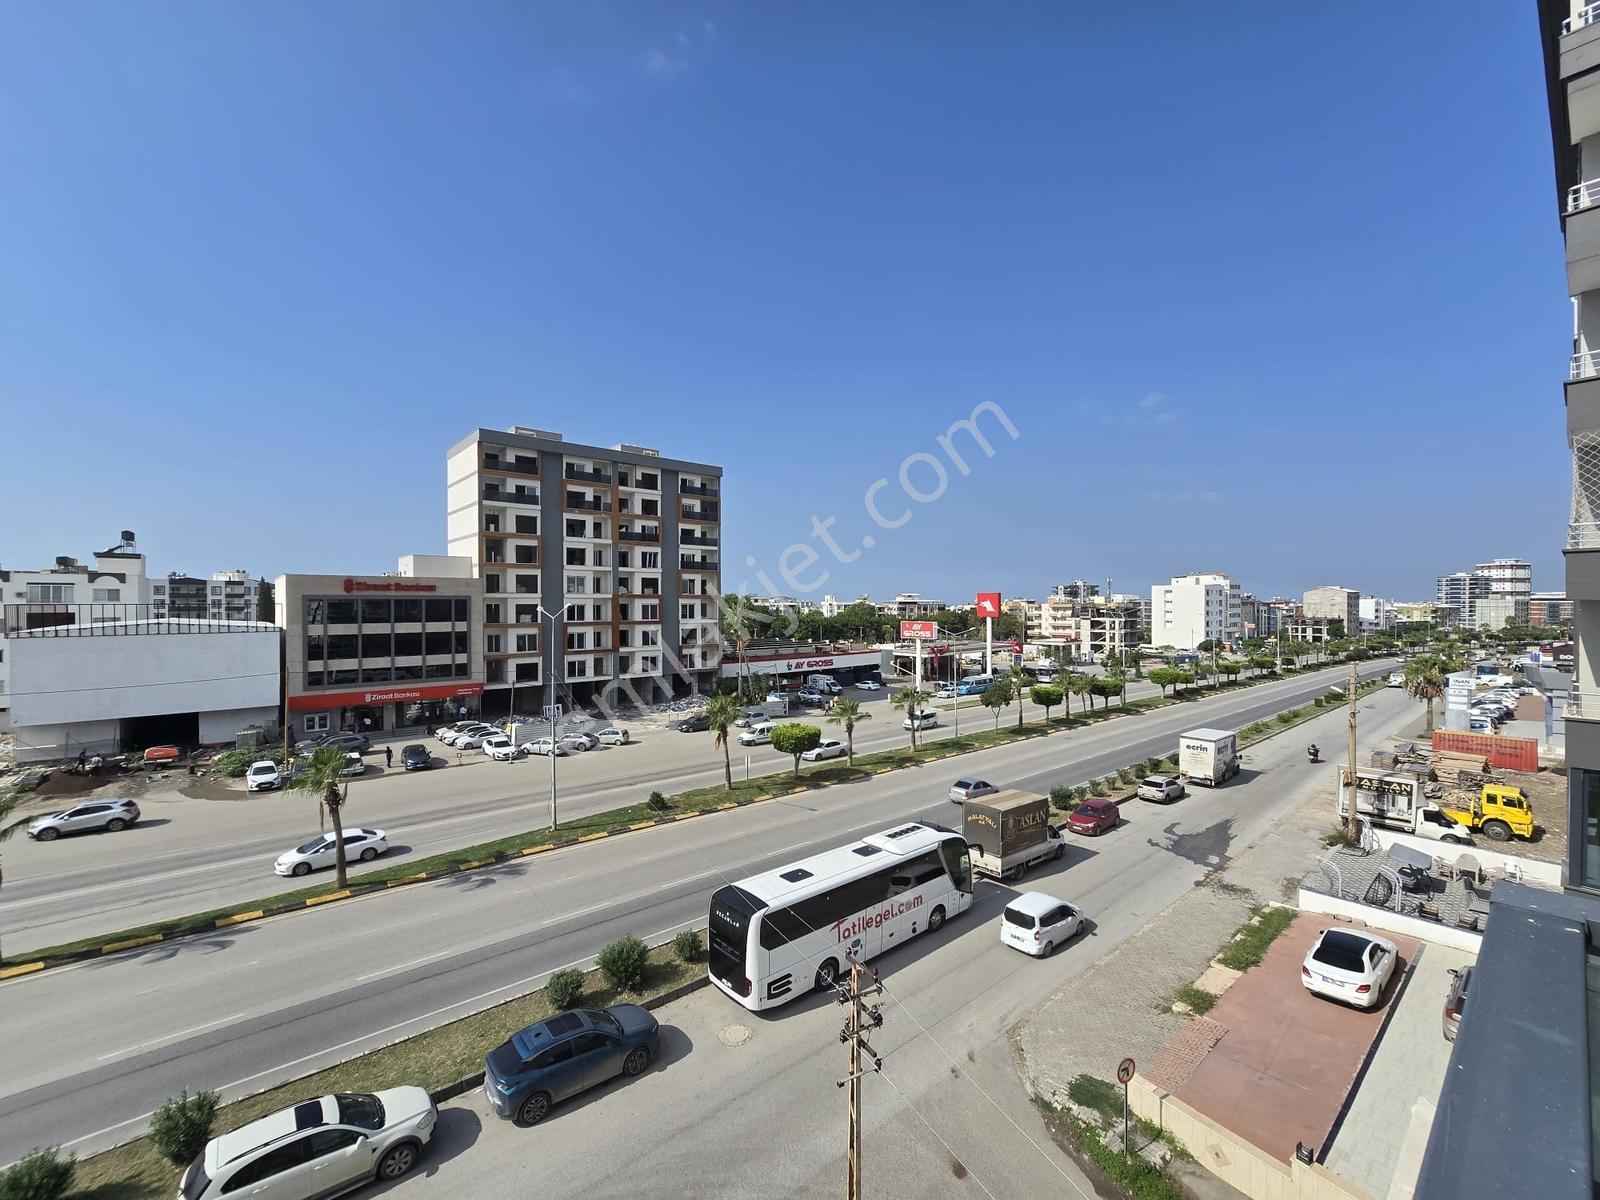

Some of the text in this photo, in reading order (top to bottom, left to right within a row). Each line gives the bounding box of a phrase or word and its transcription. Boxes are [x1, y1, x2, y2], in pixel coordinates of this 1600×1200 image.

[794, 658, 834, 669] AY GROSS
[1186, 744, 1208, 752] ecrin
[1020, 808, 1047, 829] ASLAN
[829, 894, 923, 943] Tatilegel.com
